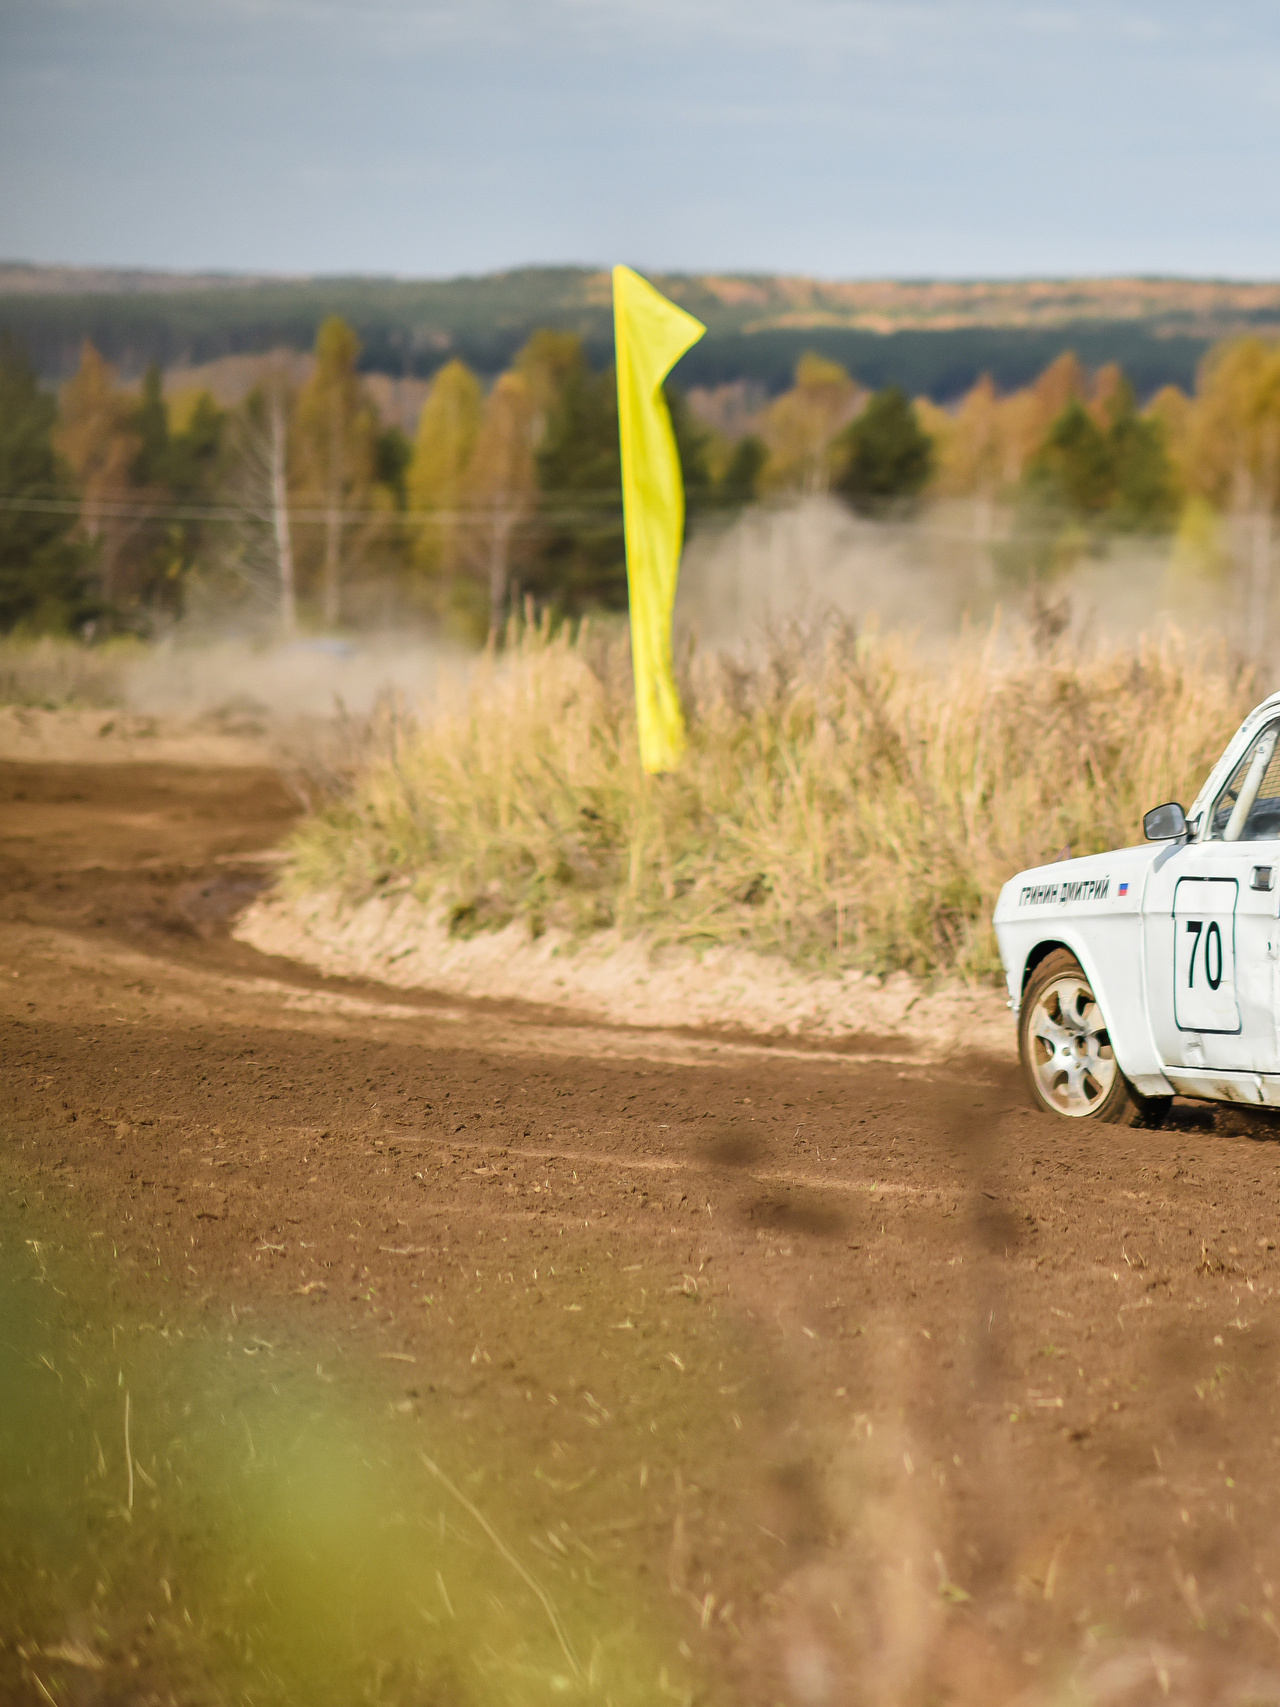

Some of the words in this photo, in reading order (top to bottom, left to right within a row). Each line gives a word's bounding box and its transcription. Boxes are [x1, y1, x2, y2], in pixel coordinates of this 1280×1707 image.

[1018, 884, 1058, 907] ГРИНИН
[1058, 873, 1111, 905] ДМИТРИЙ
[1186, 921, 1223, 991] 70
